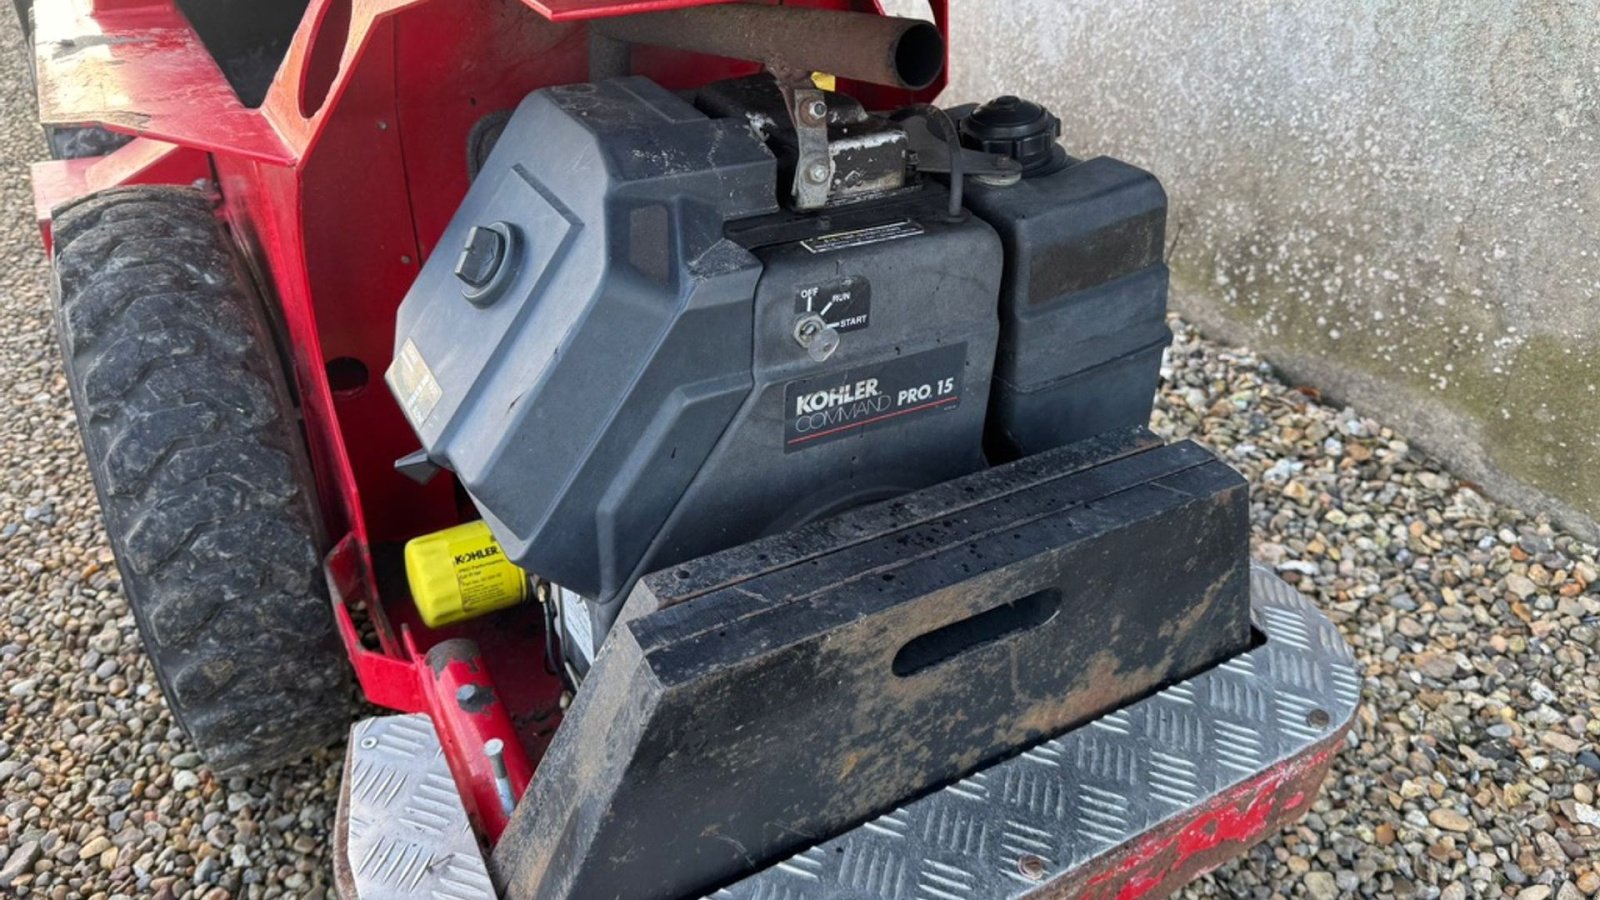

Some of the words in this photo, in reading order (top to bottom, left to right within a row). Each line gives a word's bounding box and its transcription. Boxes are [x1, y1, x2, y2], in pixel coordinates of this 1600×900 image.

[801, 287, 818, 299] OFF
[832, 292, 851, 303] RUN
[840, 314, 867, 328] START
[795, 394, 891, 432] COMMAND
[937, 377, 954, 396] 15
